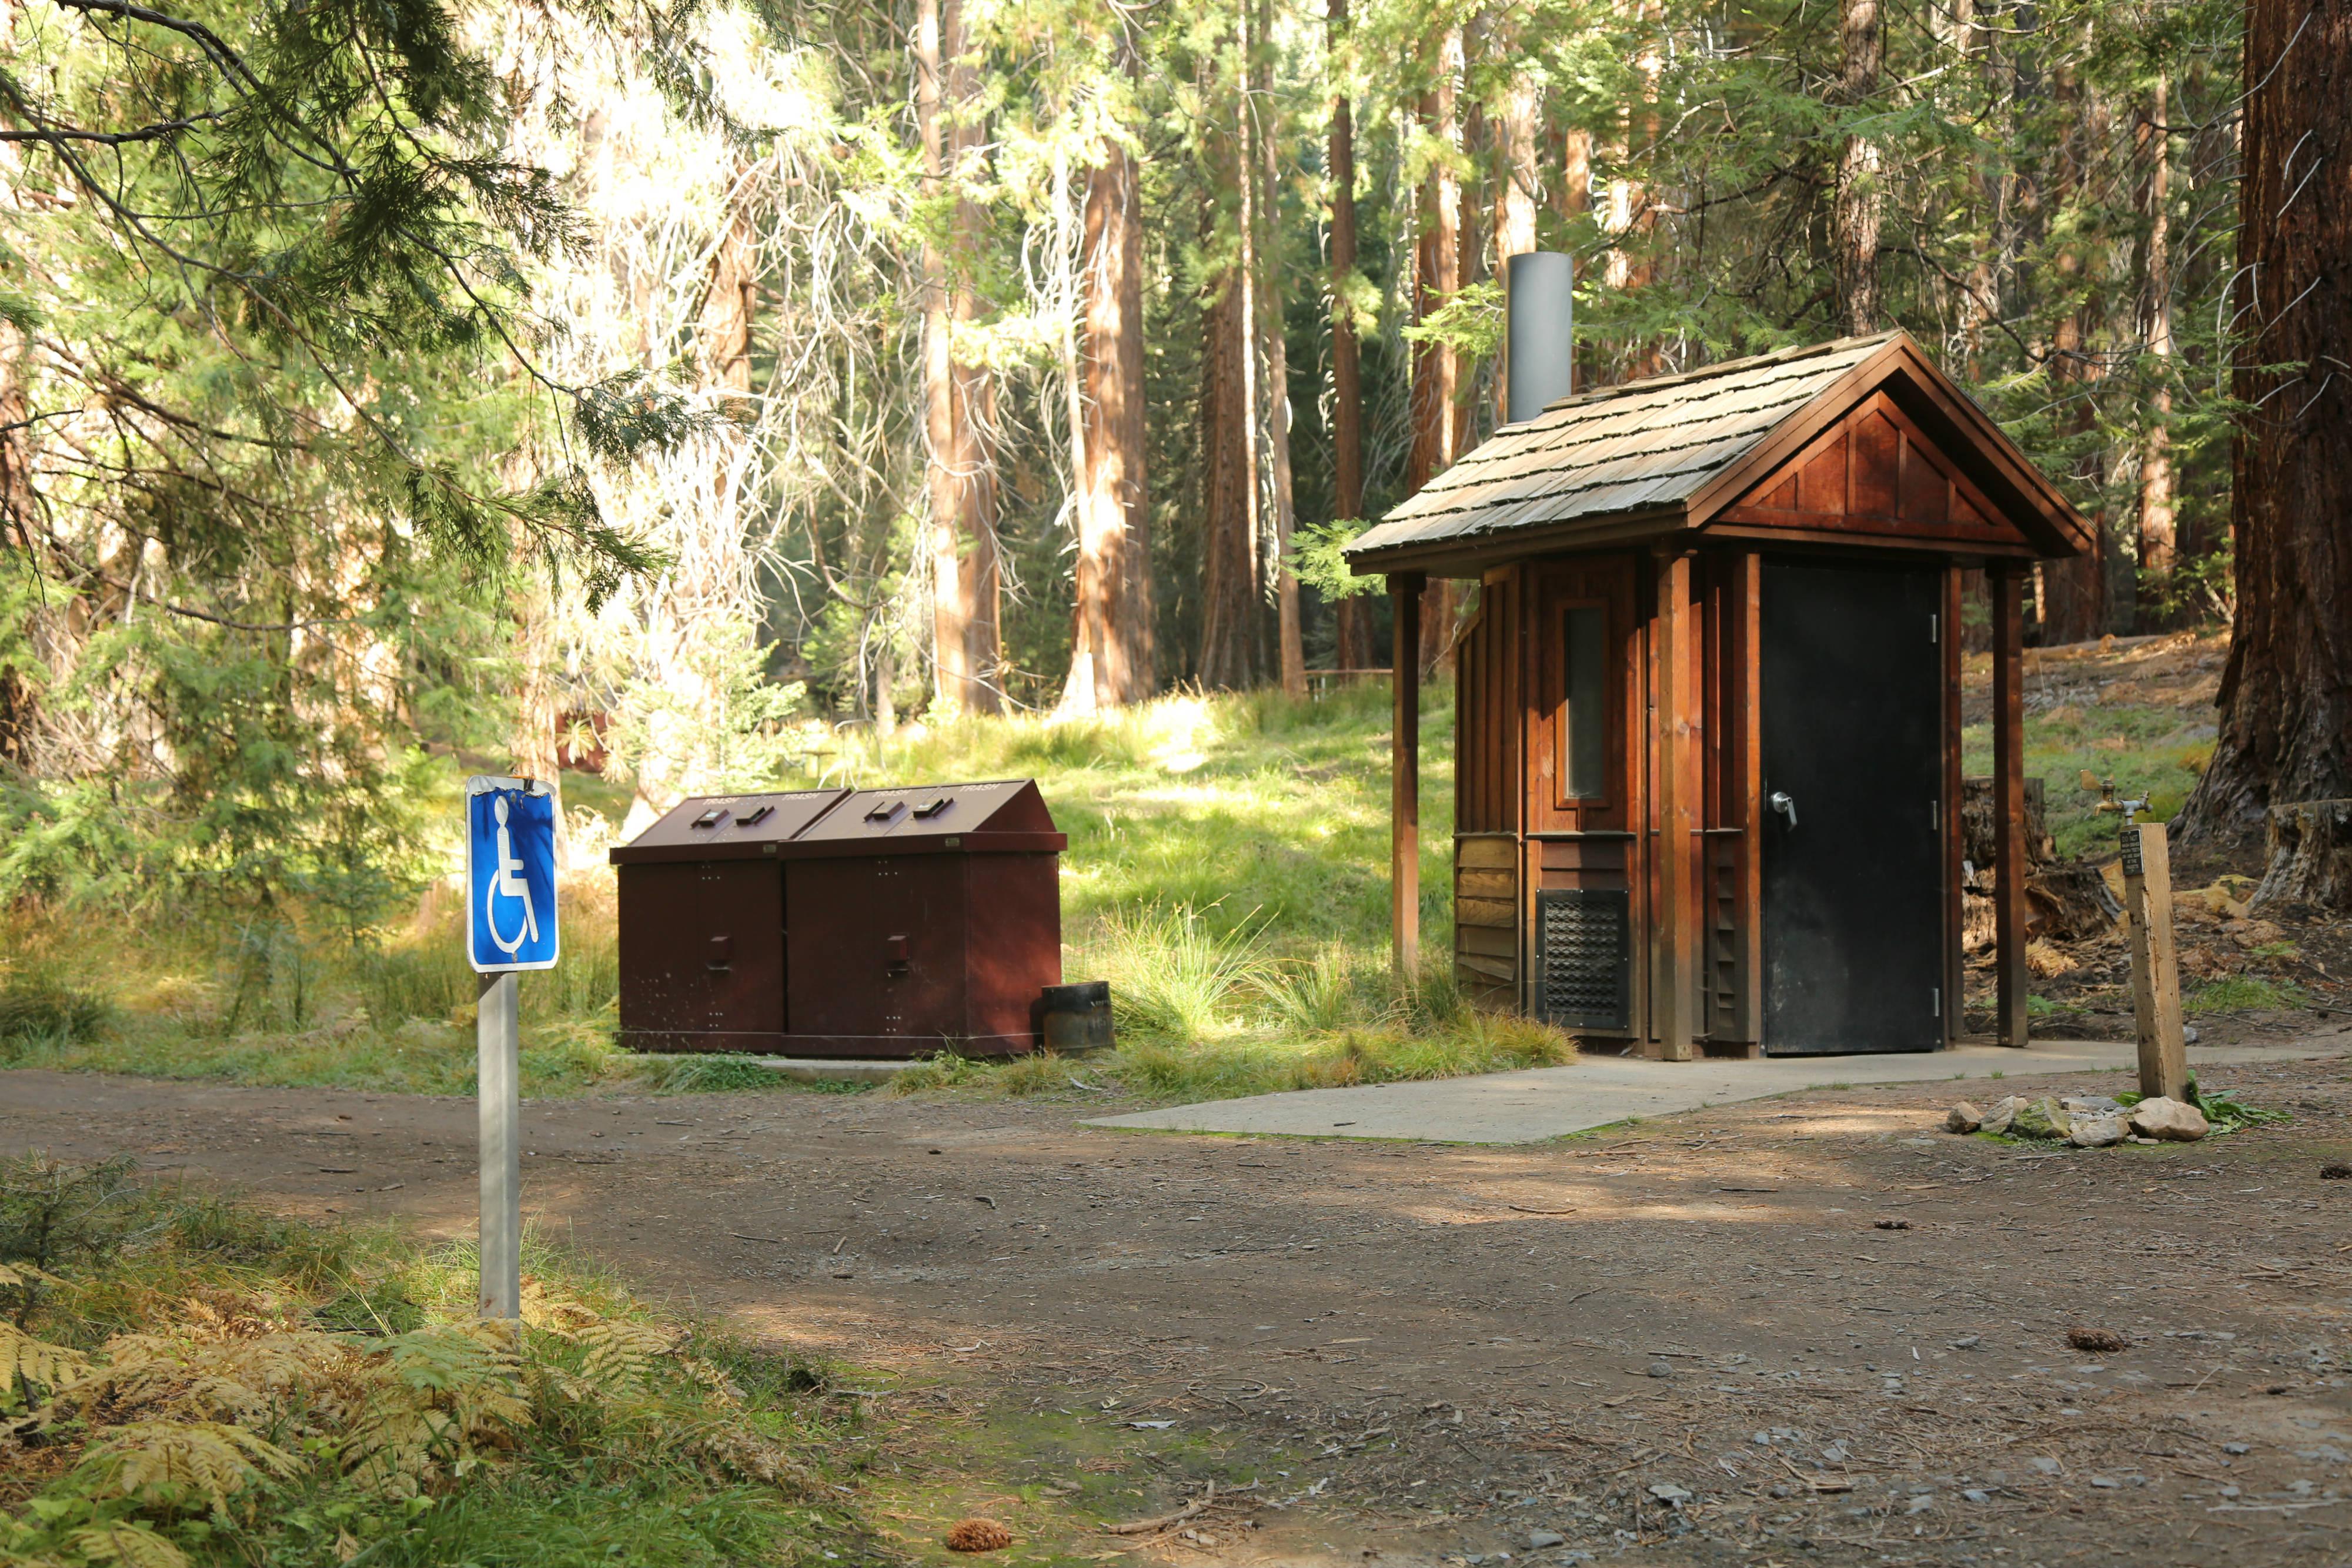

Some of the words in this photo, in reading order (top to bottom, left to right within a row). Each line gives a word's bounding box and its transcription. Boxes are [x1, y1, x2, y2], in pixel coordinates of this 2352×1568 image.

[959, 783, 1001, 793] TRASH
[781, 793, 821, 801] TRASH
[872, 789, 911, 798] TRASH
[703, 797, 740, 805] TRASH
